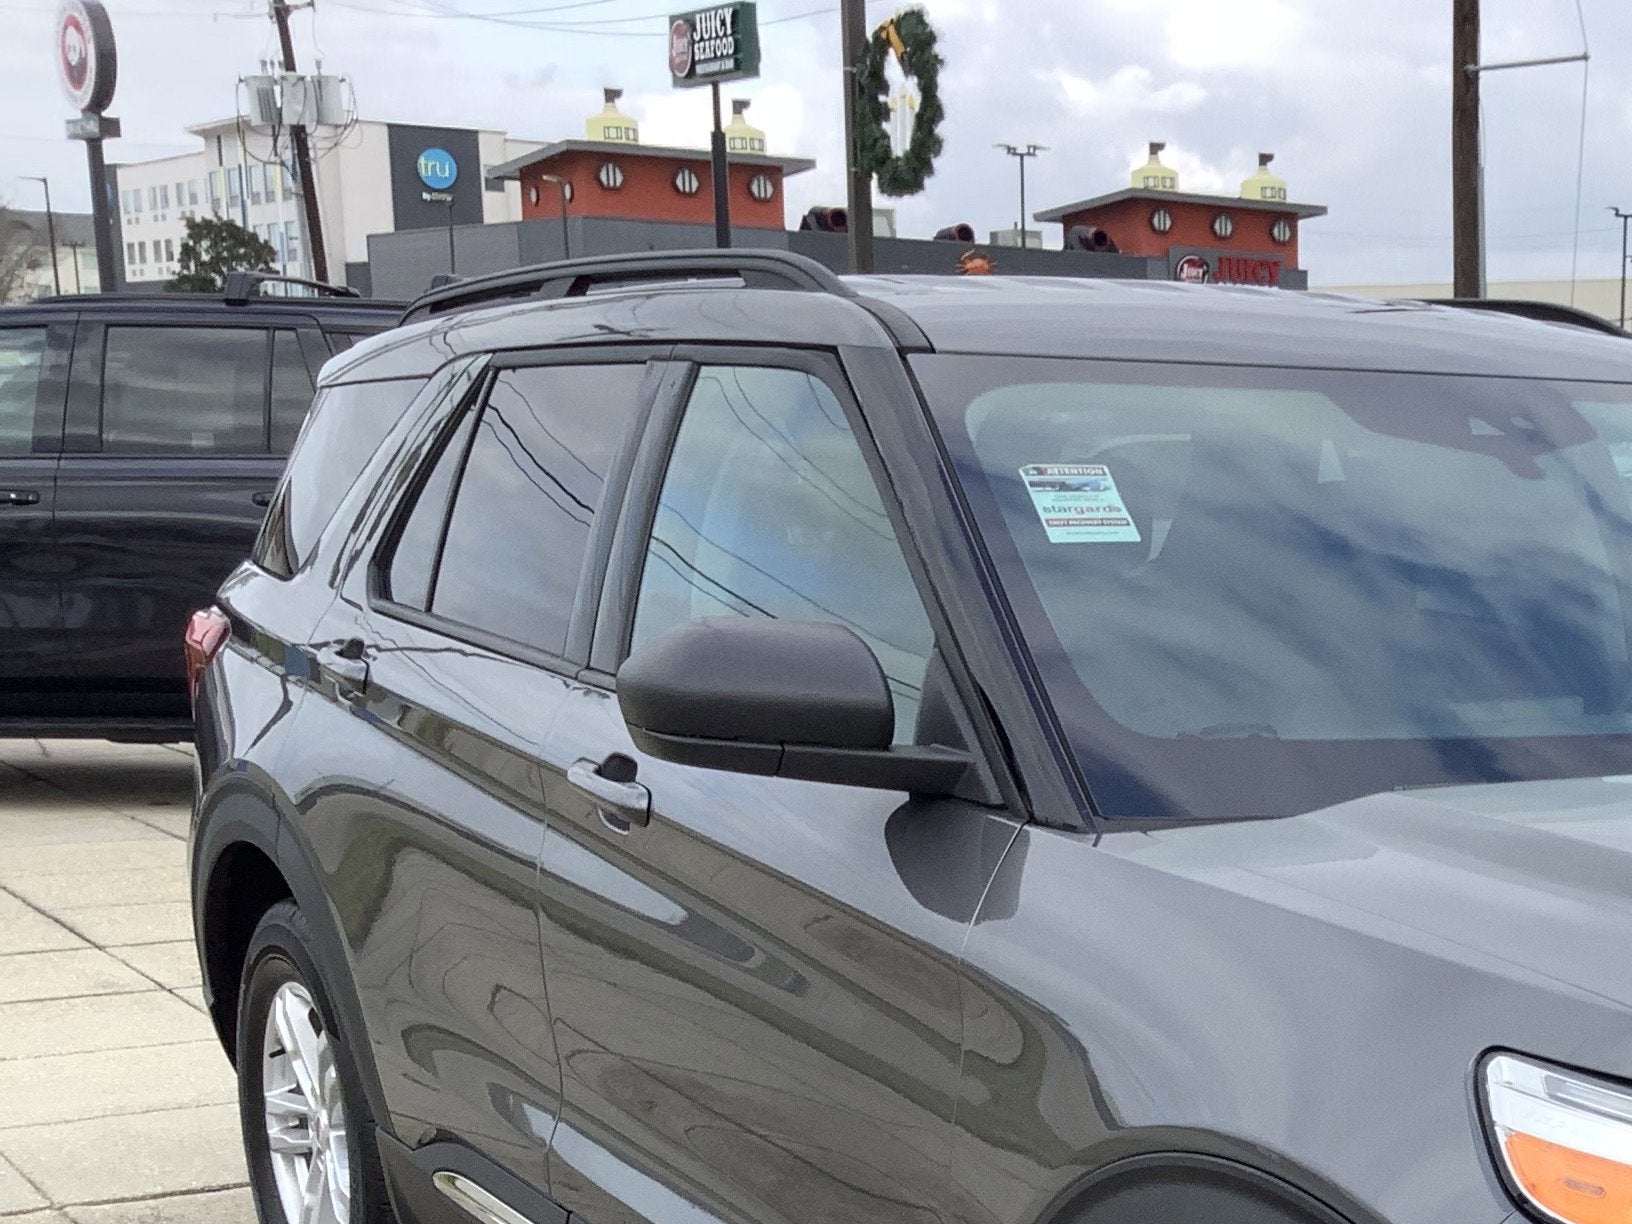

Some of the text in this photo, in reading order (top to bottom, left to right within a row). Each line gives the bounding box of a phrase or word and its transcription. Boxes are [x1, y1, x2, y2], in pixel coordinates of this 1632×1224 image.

[693, 8, 733, 41] JUICY
[694, 36, 735, 61] SEAFOOD
[419, 155, 450, 178] tru
[1213, 256, 1280, 285] JUICY
[1047, 466, 1104, 475] ATTENTION
